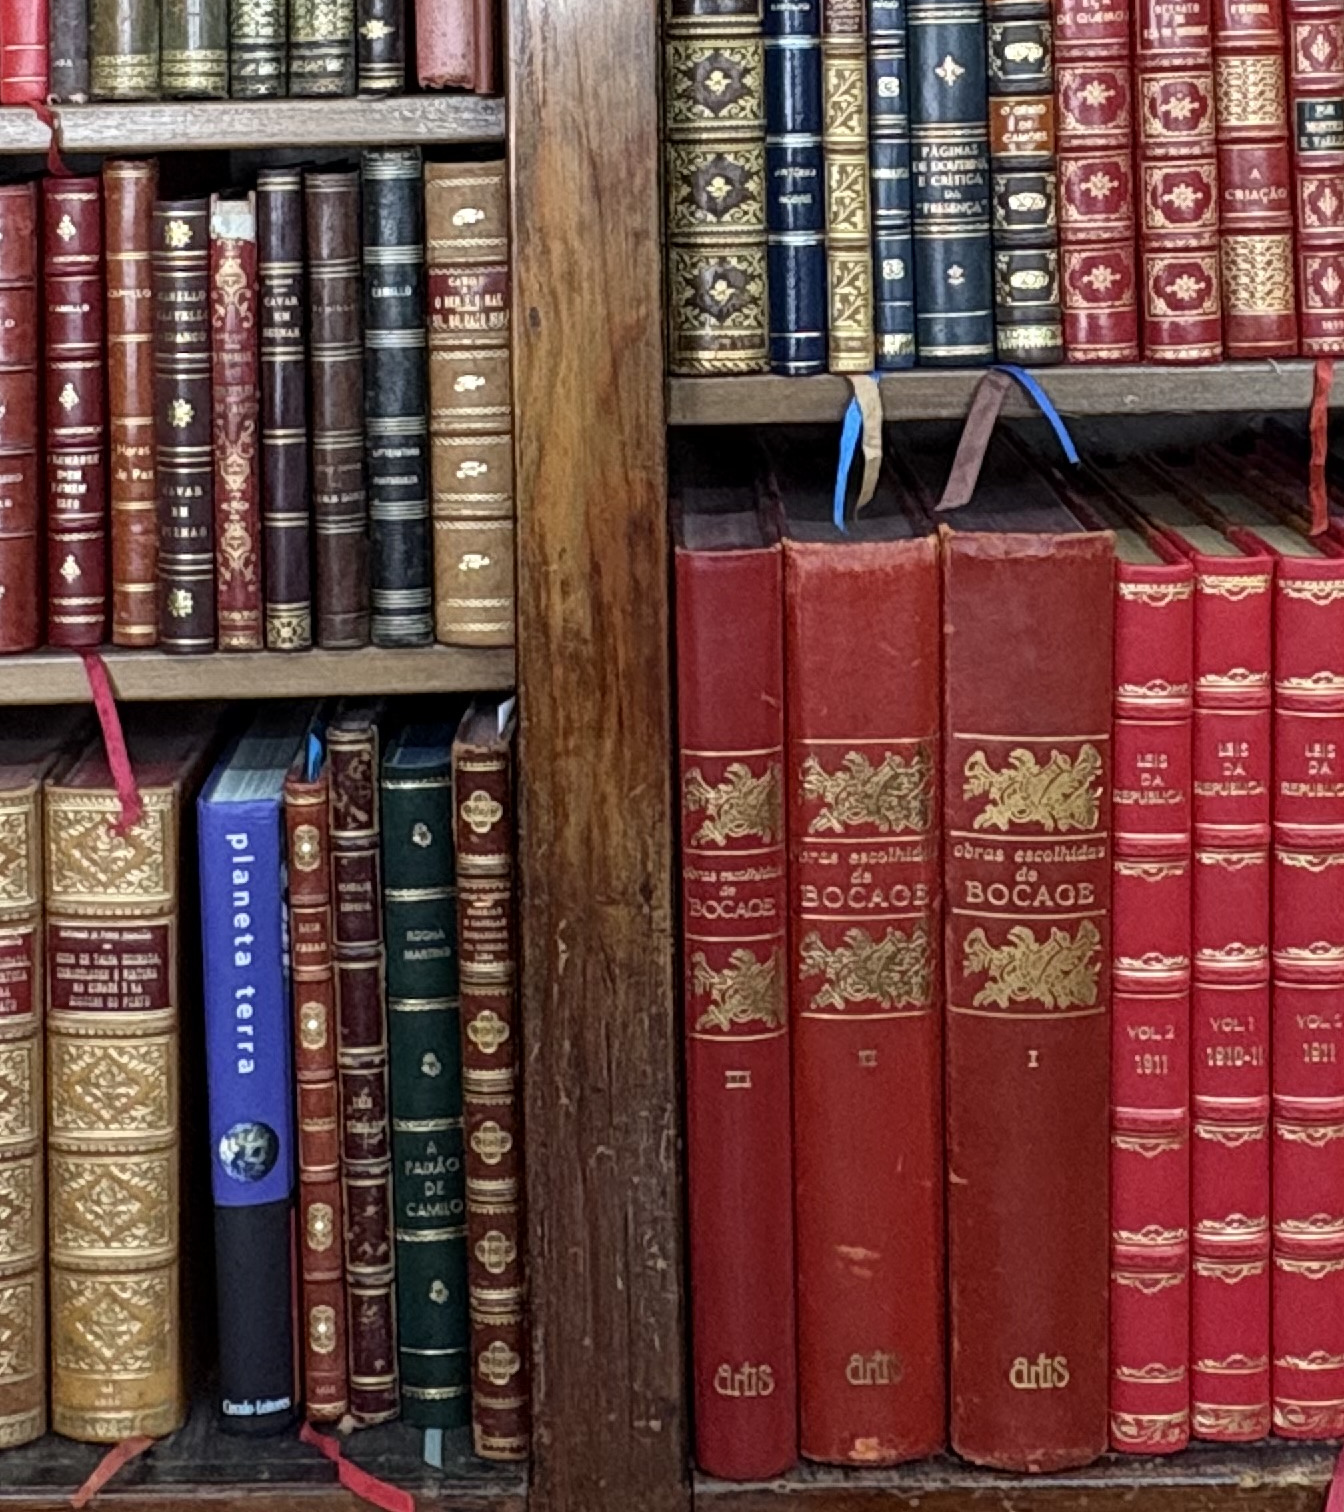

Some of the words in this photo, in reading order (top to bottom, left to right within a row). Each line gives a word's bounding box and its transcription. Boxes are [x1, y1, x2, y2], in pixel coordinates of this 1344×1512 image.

[1218, 742, 1250, 758] LEIS
[1304, 743, 1336, 759] LEIS
[1136, 752, 1168, 769] LEIS
[1223, 761, 1246, 776] DA
[1308, 762, 1332, 776] DA
[1140, 772, 1163, 787] DA
[954, 844, 1005, 861] obras
[1014, 842, 1106, 863] escolhidas
[850, 867, 872, 884] de
[1015, 867, 1038, 883] de
[225, 832, 254, 967] planeta
[801, 885, 930, 908] BOCAGE
[965, 880, 1095, 909] BOCAGE
[689, 899, 776, 919] BOCAGE
[236, 985, 255, 1075] terra
[1027, 1050, 1039, 1067] I
[1303, 1043, 1336, 1064] 1911
[1135, 1054, 1169, 1075] 1911
[427, 1140, 437, 1155] A
[425, 1180, 445, 1196] DE
[406, 1199, 463, 1217] CAMILO
[846, 1350, 904, 1386] artis
[1009, 1352, 1070, 1389] artis
[714, 1360, 776, 1397] artis
